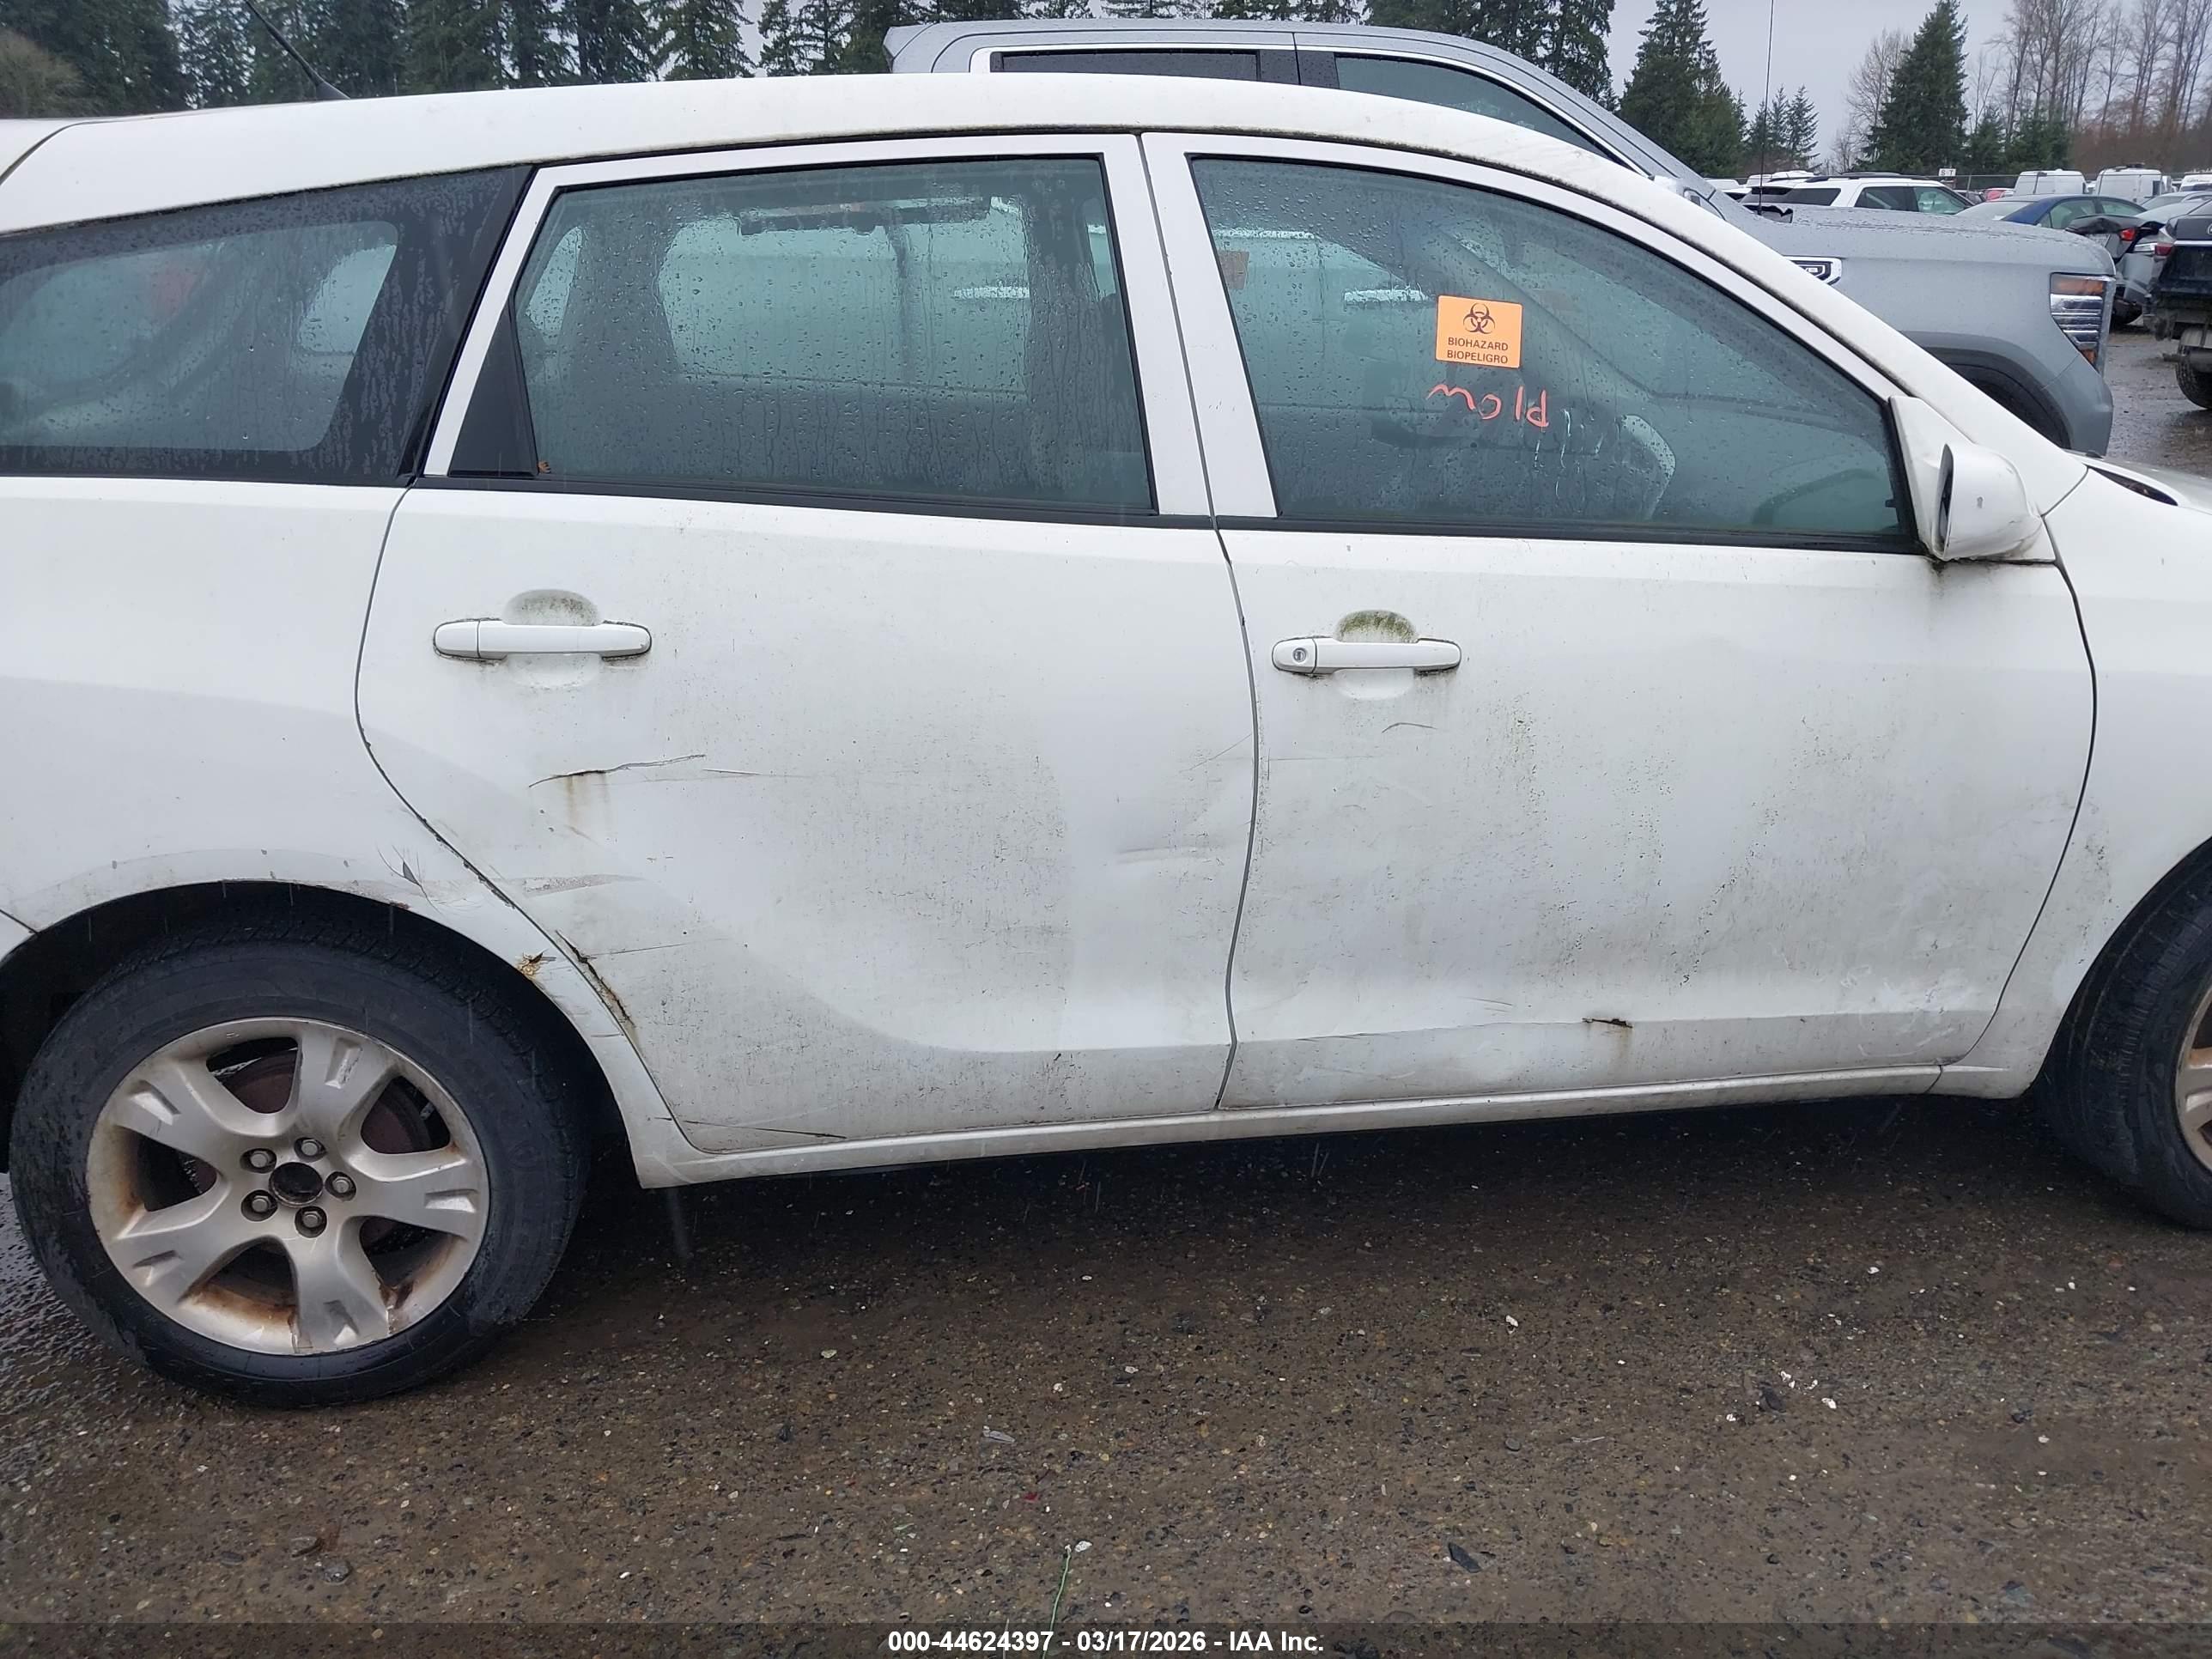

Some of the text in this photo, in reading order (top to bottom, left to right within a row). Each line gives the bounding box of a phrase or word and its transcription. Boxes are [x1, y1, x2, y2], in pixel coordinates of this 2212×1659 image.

[1448, 337, 1509, 351] BIOHAZARD
[1447, 350, 1508, 364] BIOPELIGRO
[1425, 384, 1549, 428] mold
